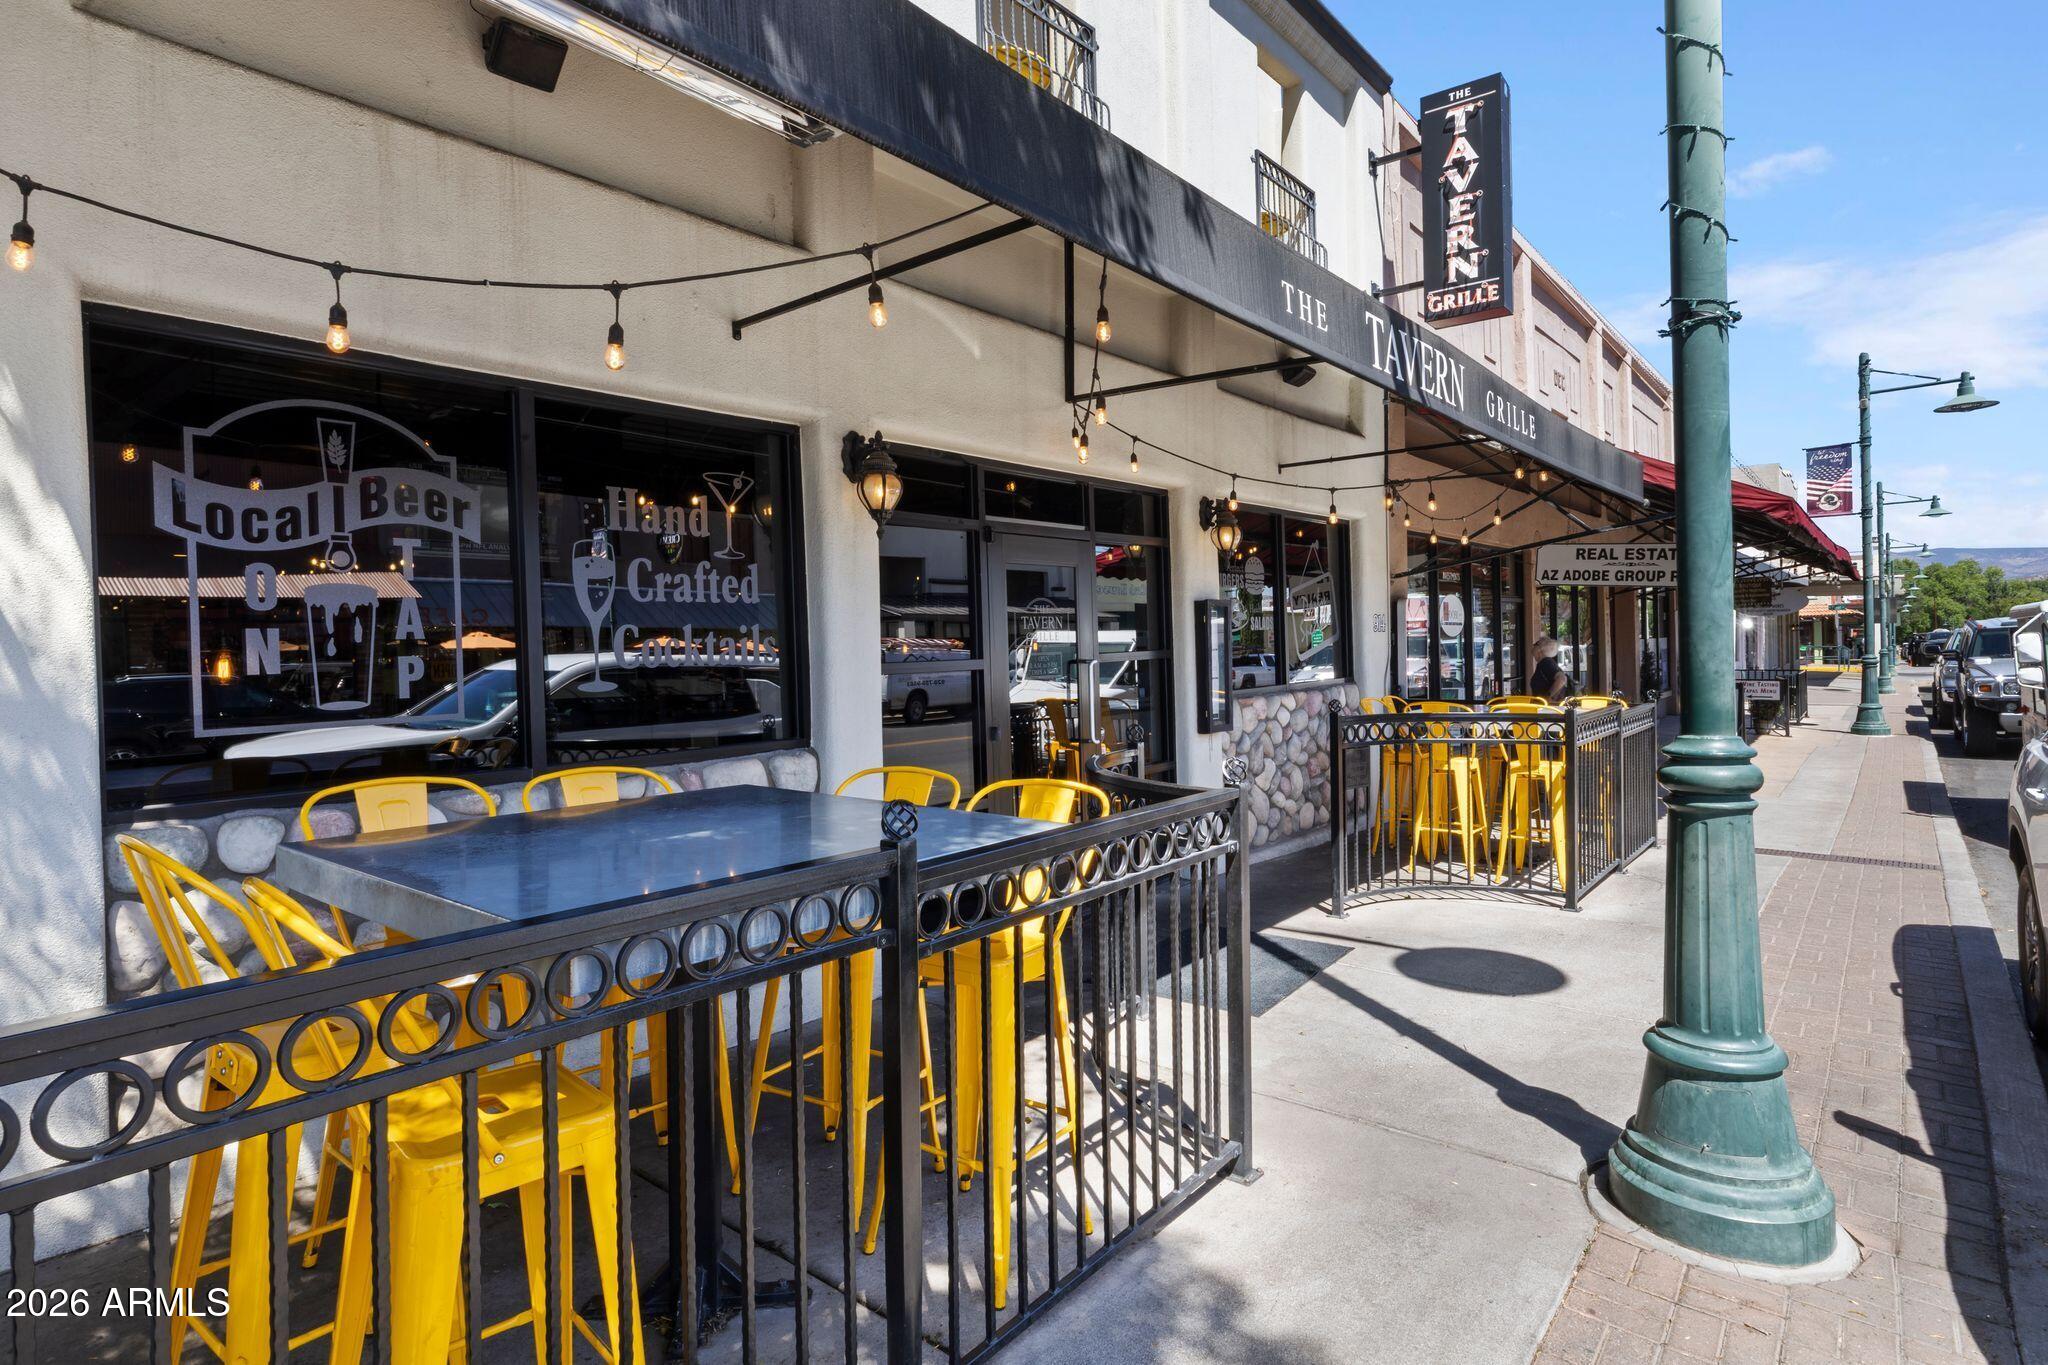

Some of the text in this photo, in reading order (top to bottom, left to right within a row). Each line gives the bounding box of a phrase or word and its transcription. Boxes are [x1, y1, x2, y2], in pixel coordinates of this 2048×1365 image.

[1448, 87, 1471, 102] THE
[1443, 104, 1480, 285] TAVERN
[1427, 284, 1500, 314] GRILLE
[1281, 280, 1537, 440] THE TAVERN GRILLE
[1809, 452, 1848, 465] freedom
[172, 475, 472, 542] Local Beer
[605, 486, 711, 537] Hand
[1576, 548, 1677, 560] REAL ESTAT
[627, 557, 761, 604] Crafted
[1221, 573, 1244, 590] RGERS
[1541, 570, 1559, 580] AZ
[1563, 570, 1610, 581] ADOBE
[1615, 570, 1666, 582] GROUP
[1021, 616, 1063, 629] TAVERN
[613, 624, 780, 669] Cocktails
